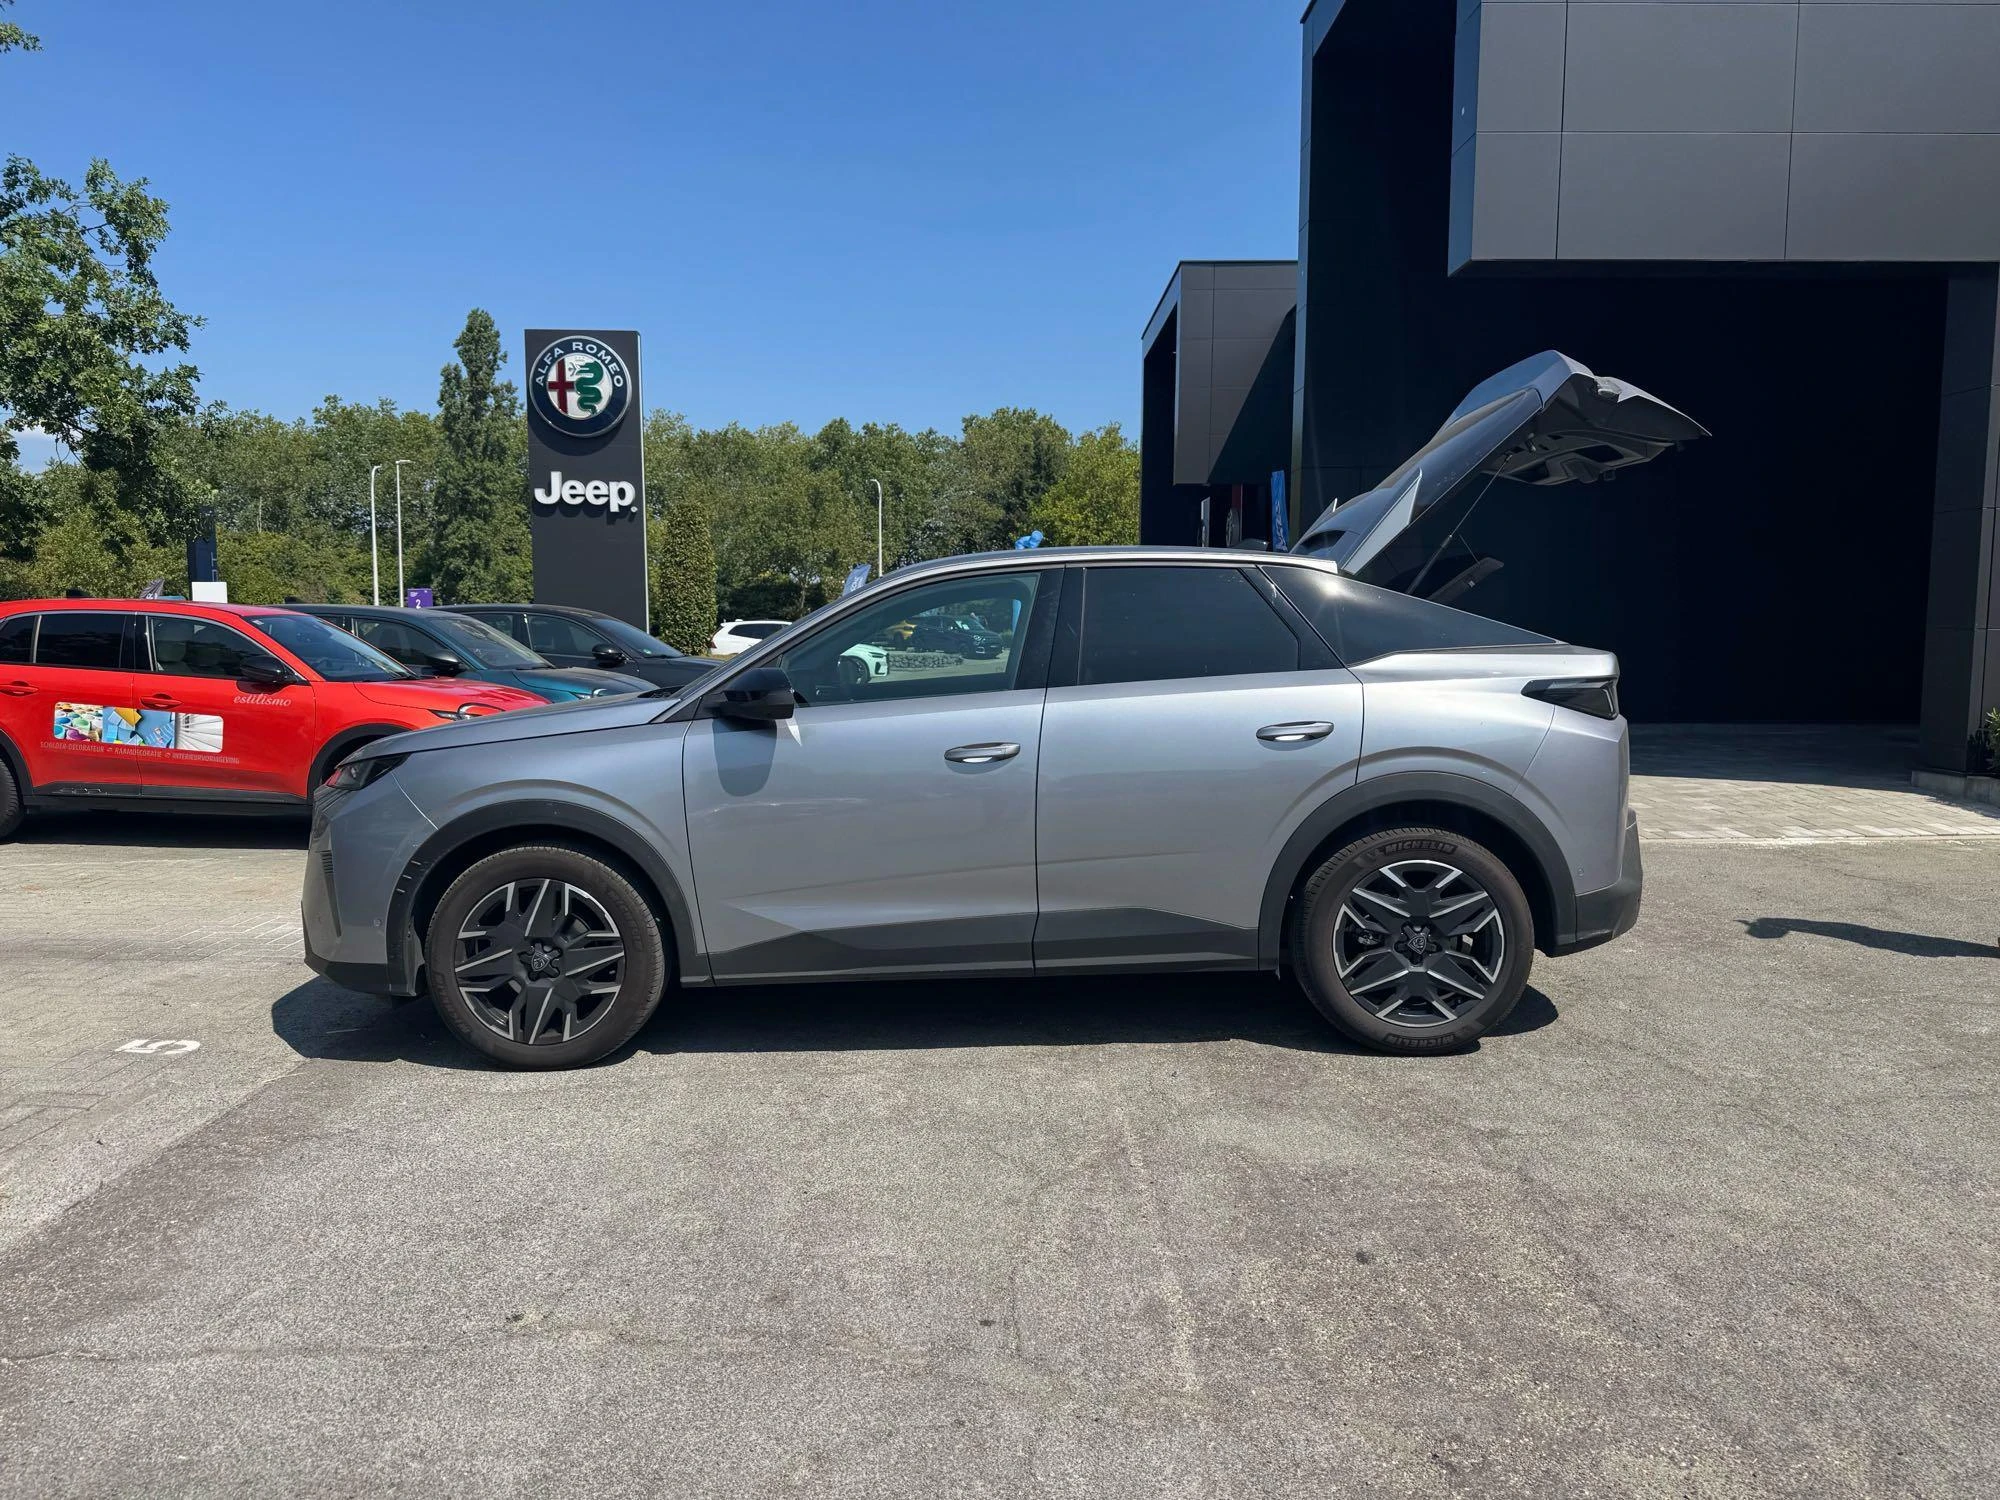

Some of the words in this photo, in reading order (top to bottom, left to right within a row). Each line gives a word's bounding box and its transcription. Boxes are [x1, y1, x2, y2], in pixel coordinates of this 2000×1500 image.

[536, 347, 564, 387] ALFA
[572, 341, 624, 387] ROMEO
[415, 598, 421, 609] 2
[233, 693, 292, 706] estilismo
[1385, 840, 1455, 854] MICHELIN
[114, 1039, 200, 1055] 5
